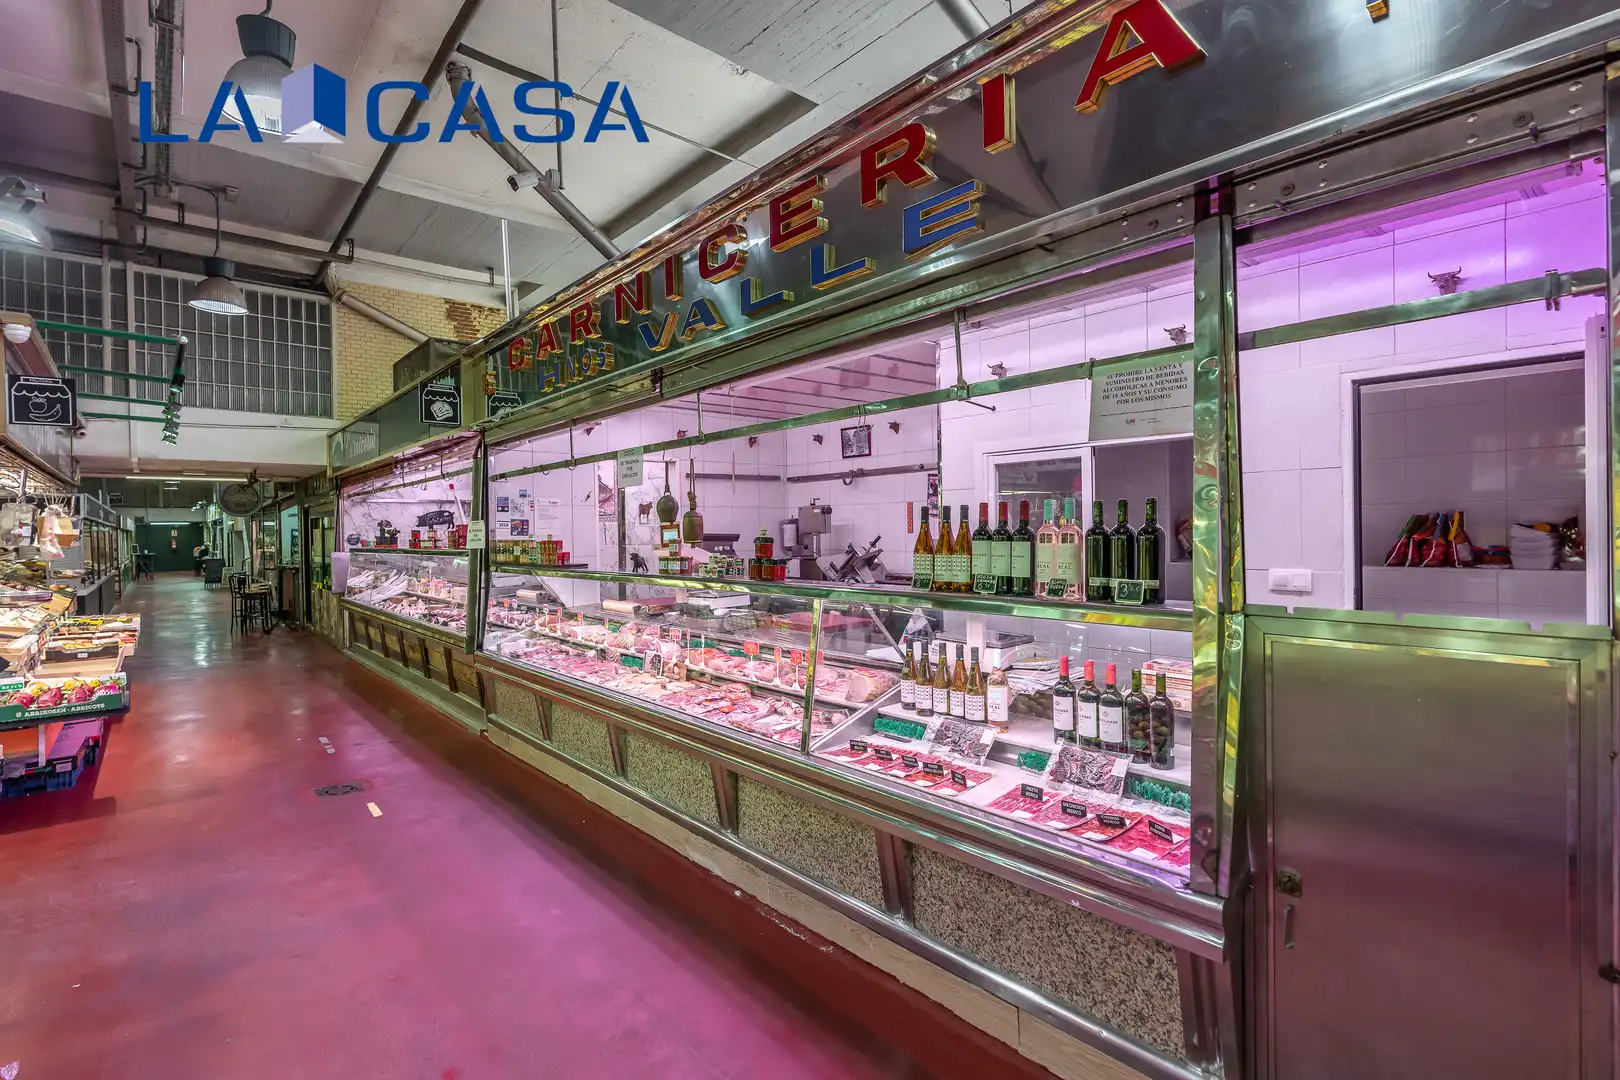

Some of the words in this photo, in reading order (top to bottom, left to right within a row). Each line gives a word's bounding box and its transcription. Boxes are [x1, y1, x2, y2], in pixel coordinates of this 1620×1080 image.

[638, 178, 986, 352] VALLE
[539, 342, 615, 392] HNOS
[1154, 364, 1177, 372] VENTA
[1105, 375, 1145, 386] SUMINISTRO
[1155, 370, 1185, 379] BEBIDAS
[1154, 376, 1188, 386] MENORES
[1119, 389, 1137, 398] AÑOS
[1153, 383, 1188, 393] CONSUMO
[1116, 397, 1130, 405] POR
[1144, 393, 1172, 401] MISMOS
[24, 708, 67, 717] ABRIKOSEN
[70, 703, 105, 712] ABRICOTS
